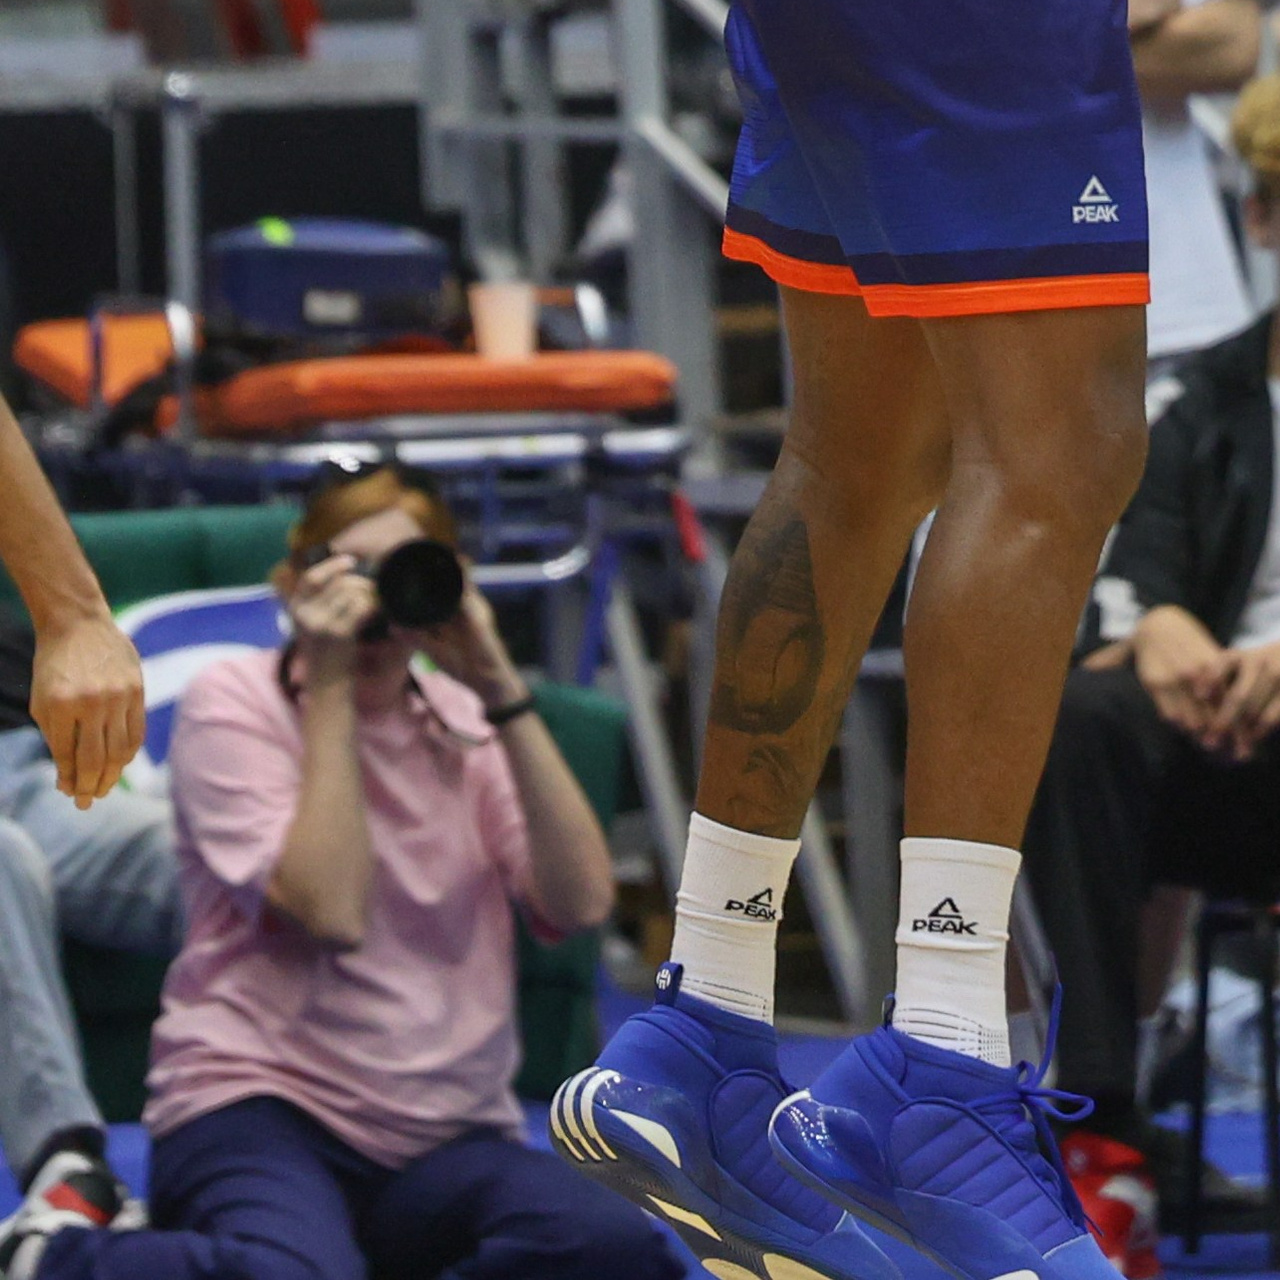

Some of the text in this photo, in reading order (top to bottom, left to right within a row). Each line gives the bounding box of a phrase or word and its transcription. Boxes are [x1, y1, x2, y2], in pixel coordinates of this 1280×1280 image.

[1072, 203, 1121, 224] PEAK
[724, 898, 777, 921] PEAK
[912, 917, 979, 937] PEAK
